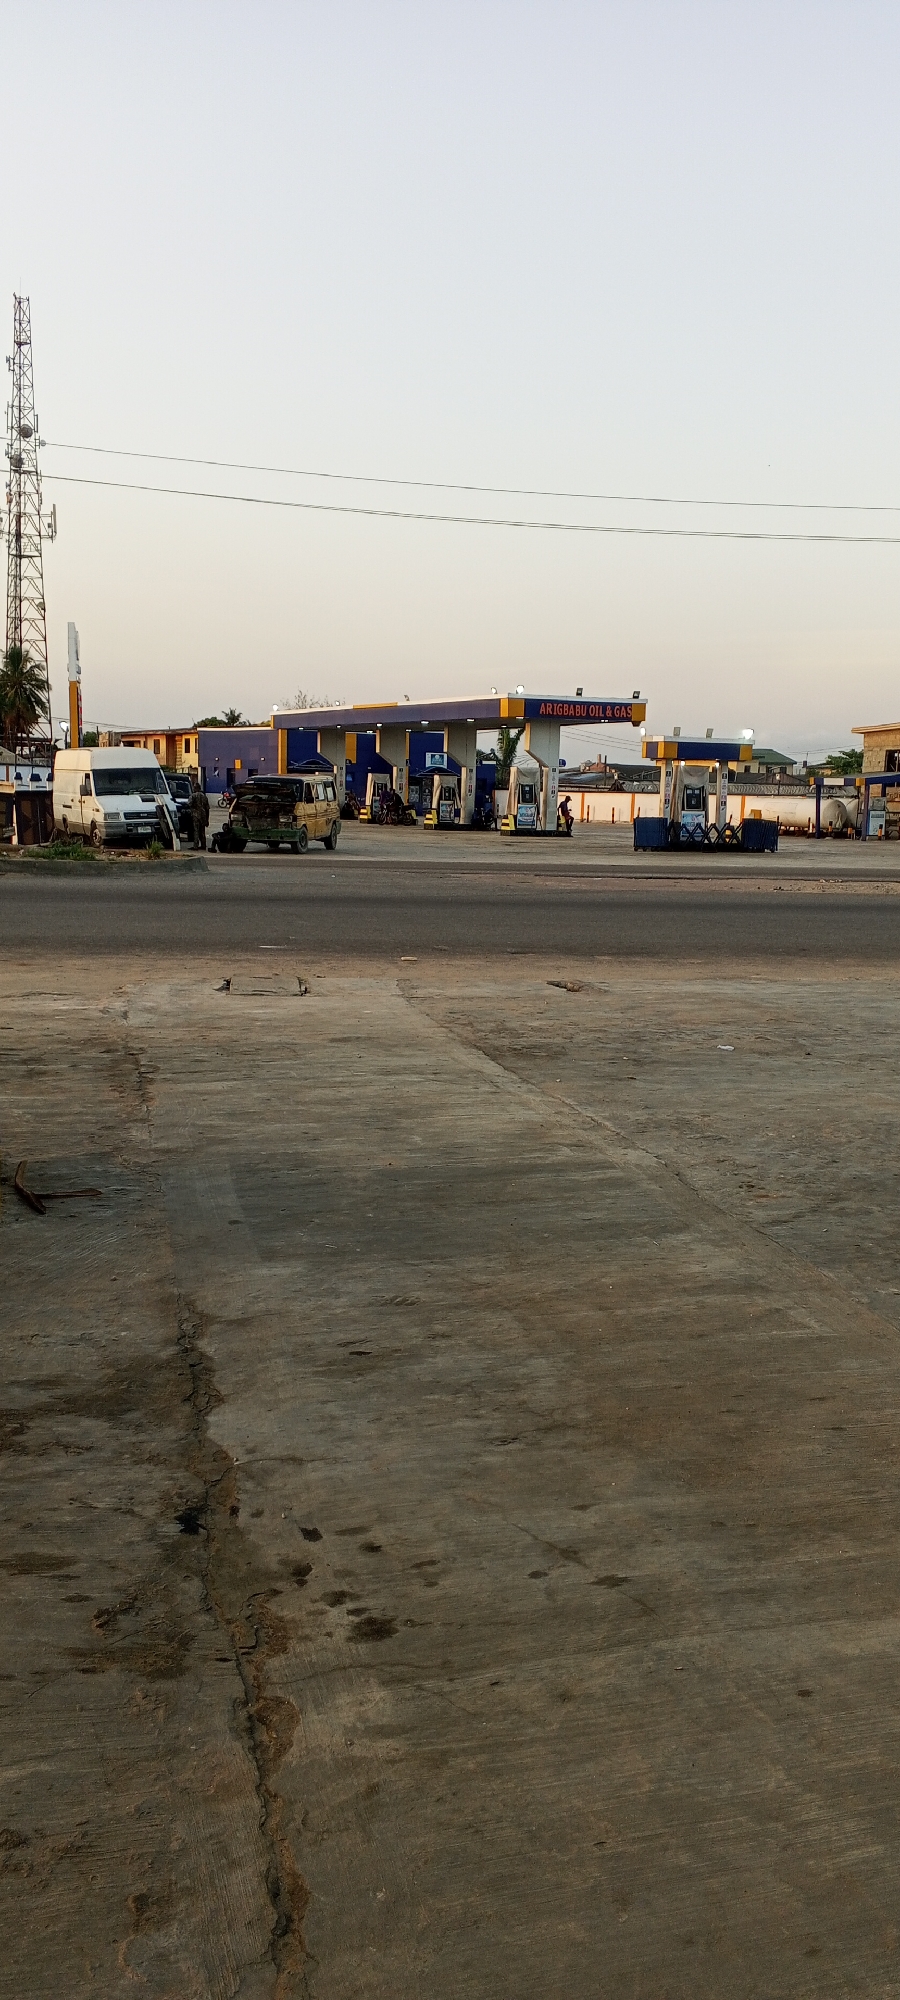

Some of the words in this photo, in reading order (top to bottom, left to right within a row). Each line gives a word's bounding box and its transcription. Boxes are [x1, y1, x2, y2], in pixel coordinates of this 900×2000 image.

[540, 703, 587, 716] ARIGBABU
[589, 705, 604, 717] OIL
[606, 706, 613, 717] &
[614, 706, 632, 718] GAS
